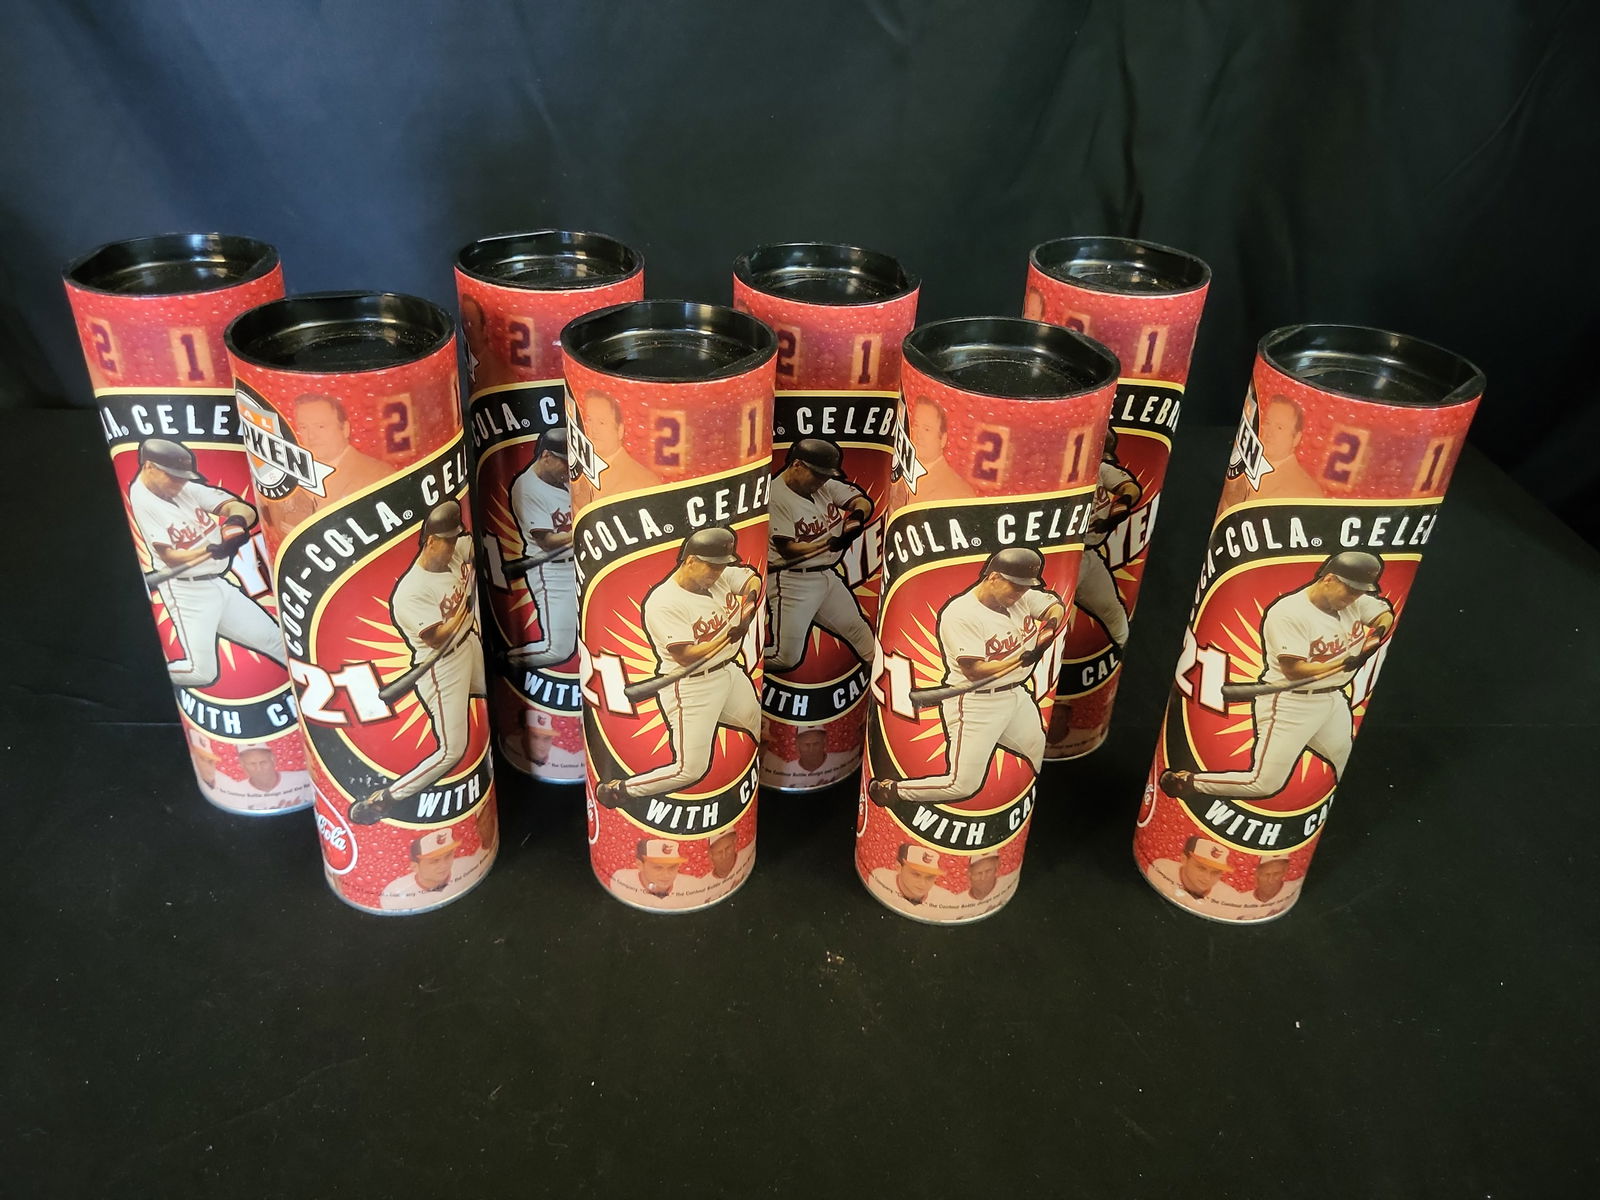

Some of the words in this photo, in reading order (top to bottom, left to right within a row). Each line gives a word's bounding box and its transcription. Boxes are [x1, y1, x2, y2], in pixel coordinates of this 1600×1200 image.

[180, 333, 205, 382] 1
[508, 320, 532, 368] 2
[858, 339, 873, 385] 1
[1140, 331, 1159, 374] 1
[131, 404, 245, 436] CELE
[382, 401, 411, 454] 2
[654, 416, 681, 467] 2
[747, 407, 758, 459] 1
[796, 406, 898, 437] CELEB
[971, 430, 1004, 483] 2
[1067, 432, 1086, 484] 1
[1324, 431, 1361, 483] 2
[1420, 442, 1445, 492] 1
[289, 658, 393, 724] 21
[523, 671, 583, 708] WITH
[1081, 652, 1119, 687] CAL
[181, 688, 242, 735] WITH
[762, 682, 809, 717] ITH
[832, 671, 869, 710] CAL
[416, 773, 481, 818] WITH
[645, 798, 719, 830] WITH
[911, 805, 986, 846] WITH
[1205, 799, 1283, 846] WITH
